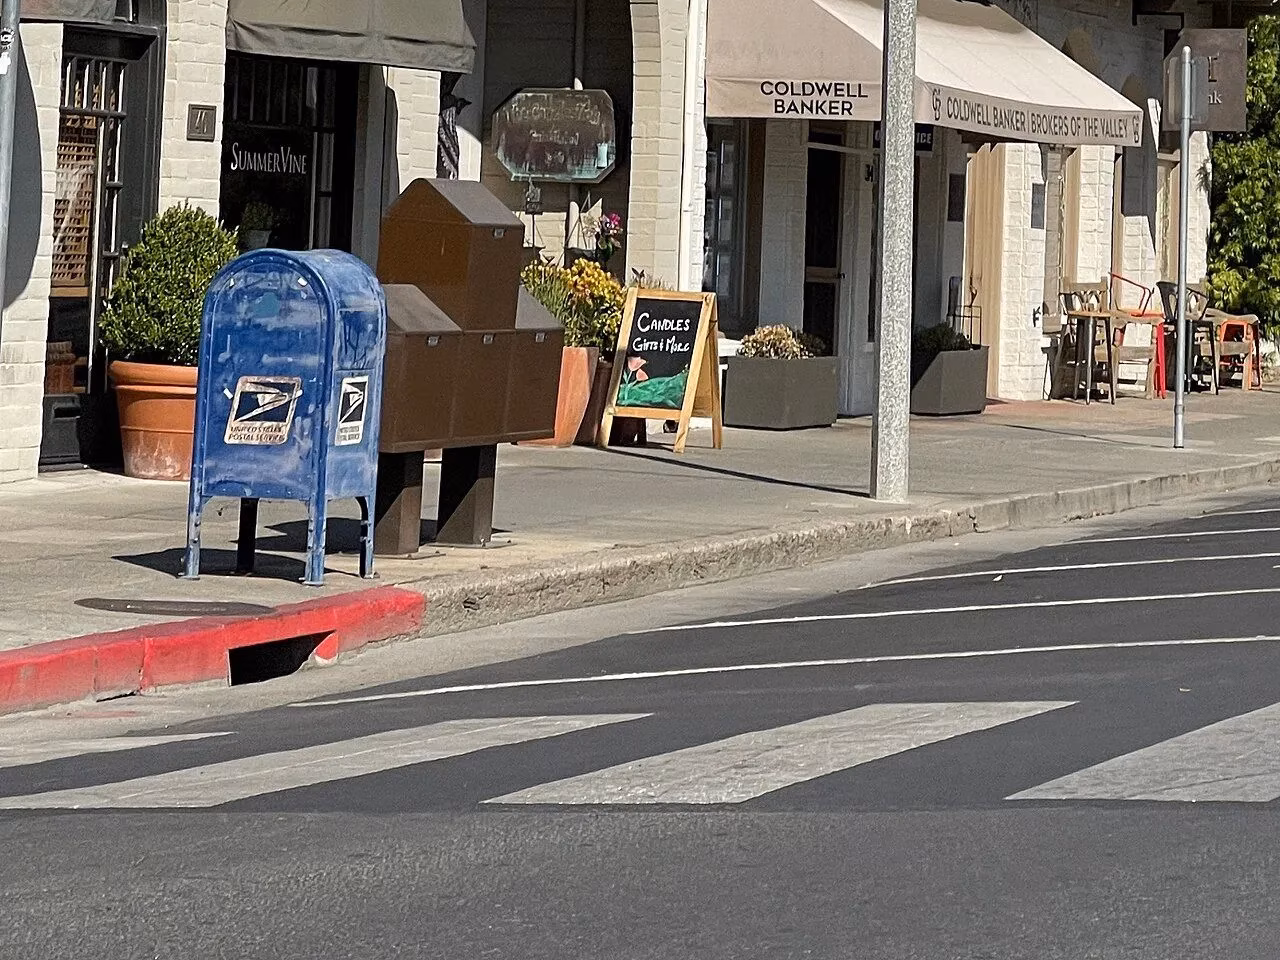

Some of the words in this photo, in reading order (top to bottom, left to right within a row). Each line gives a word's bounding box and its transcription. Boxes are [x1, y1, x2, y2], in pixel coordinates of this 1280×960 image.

[760, 81, 869, 99] COLDWELL
[774, 98, 853, 116] BANKER
[946, 96, 991, 126] COLDWELL
[993, 106, 1026, 133] BANKER
[1030, 113, 1069, 136] BROKERS
[1071, 116, 1081, 137] OF
[1083, 117, 1098, 137] THE
[1100, 118, 1128, 138] VALLEY
